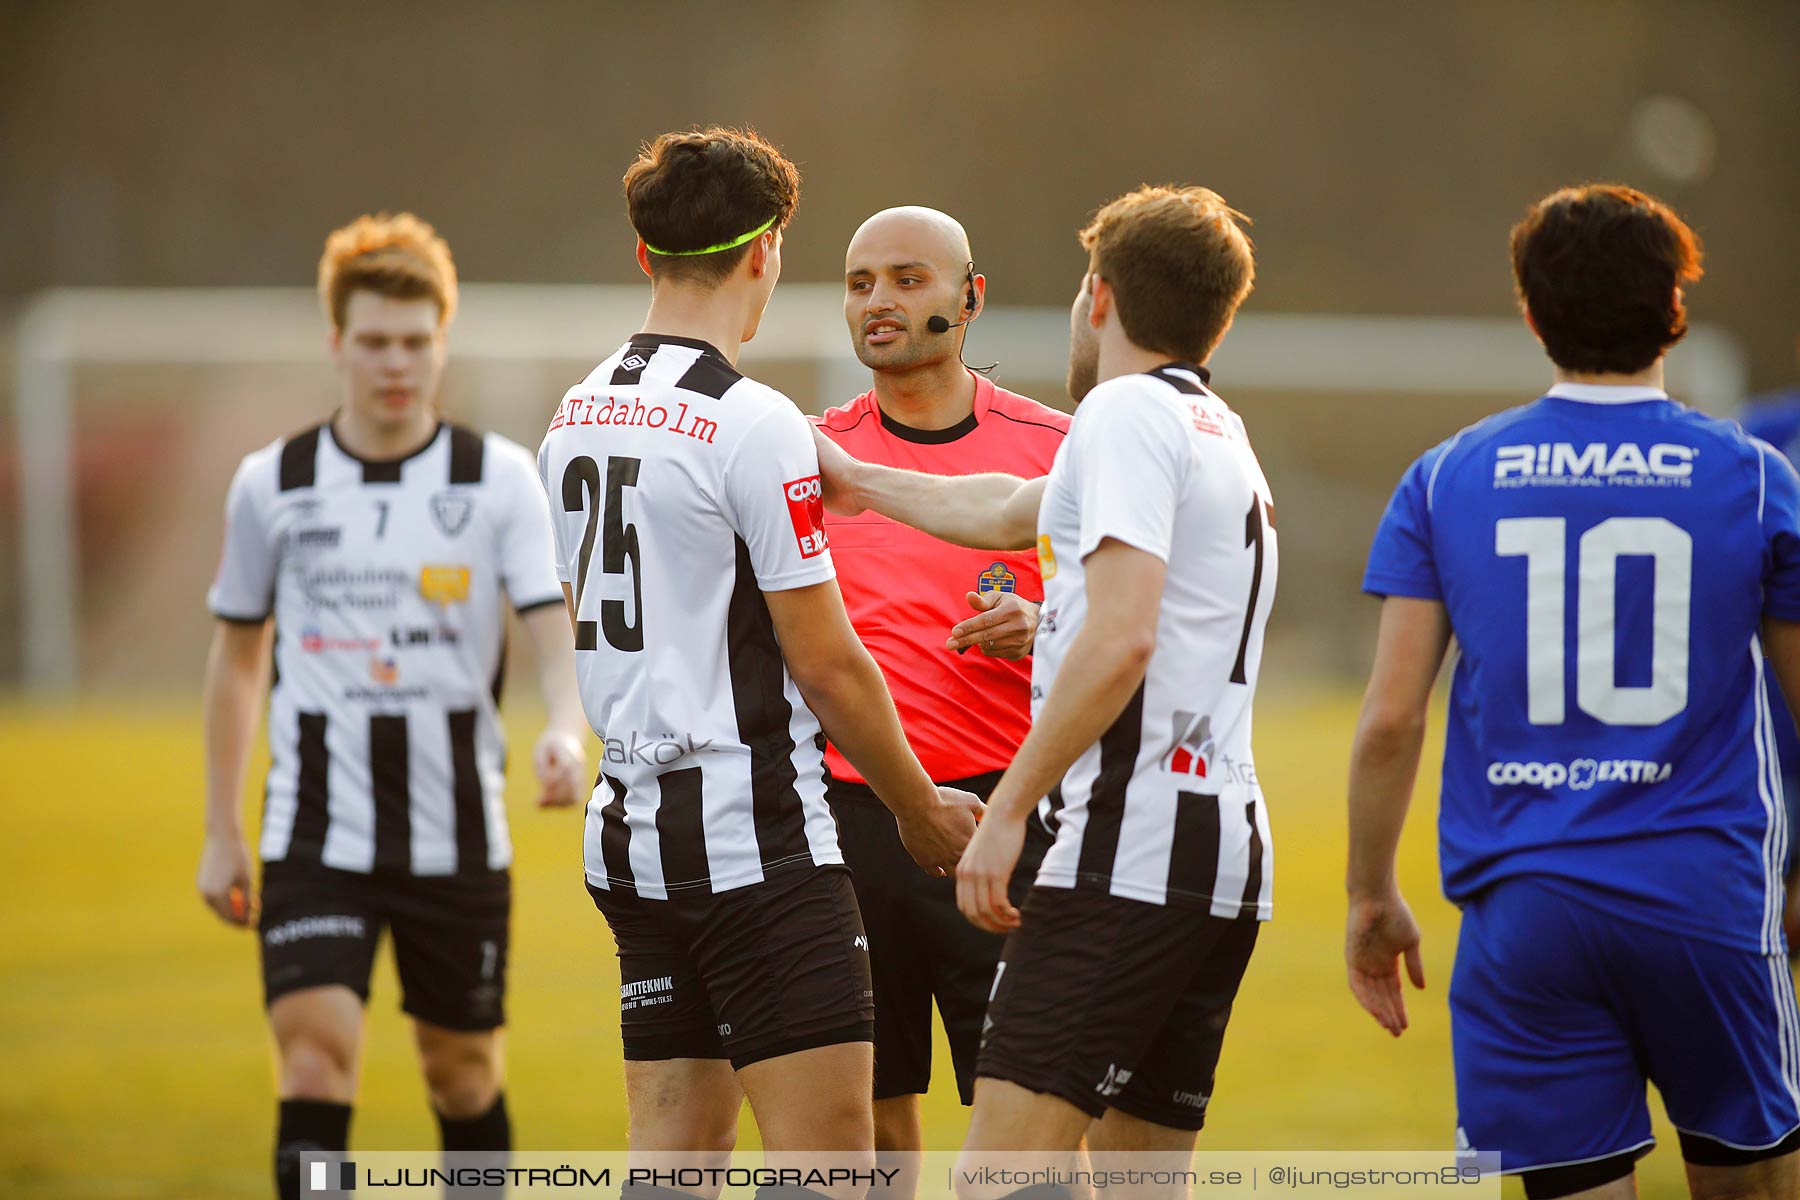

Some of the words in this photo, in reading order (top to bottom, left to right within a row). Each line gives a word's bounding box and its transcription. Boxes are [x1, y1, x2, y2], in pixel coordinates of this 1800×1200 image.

[565, 395, 718, 444] Tidaholm
[561, 455, 645, 653] 25
[1494, 516, 1693, 727] 10
[1597, 759, 1672, 784] EXTRA
